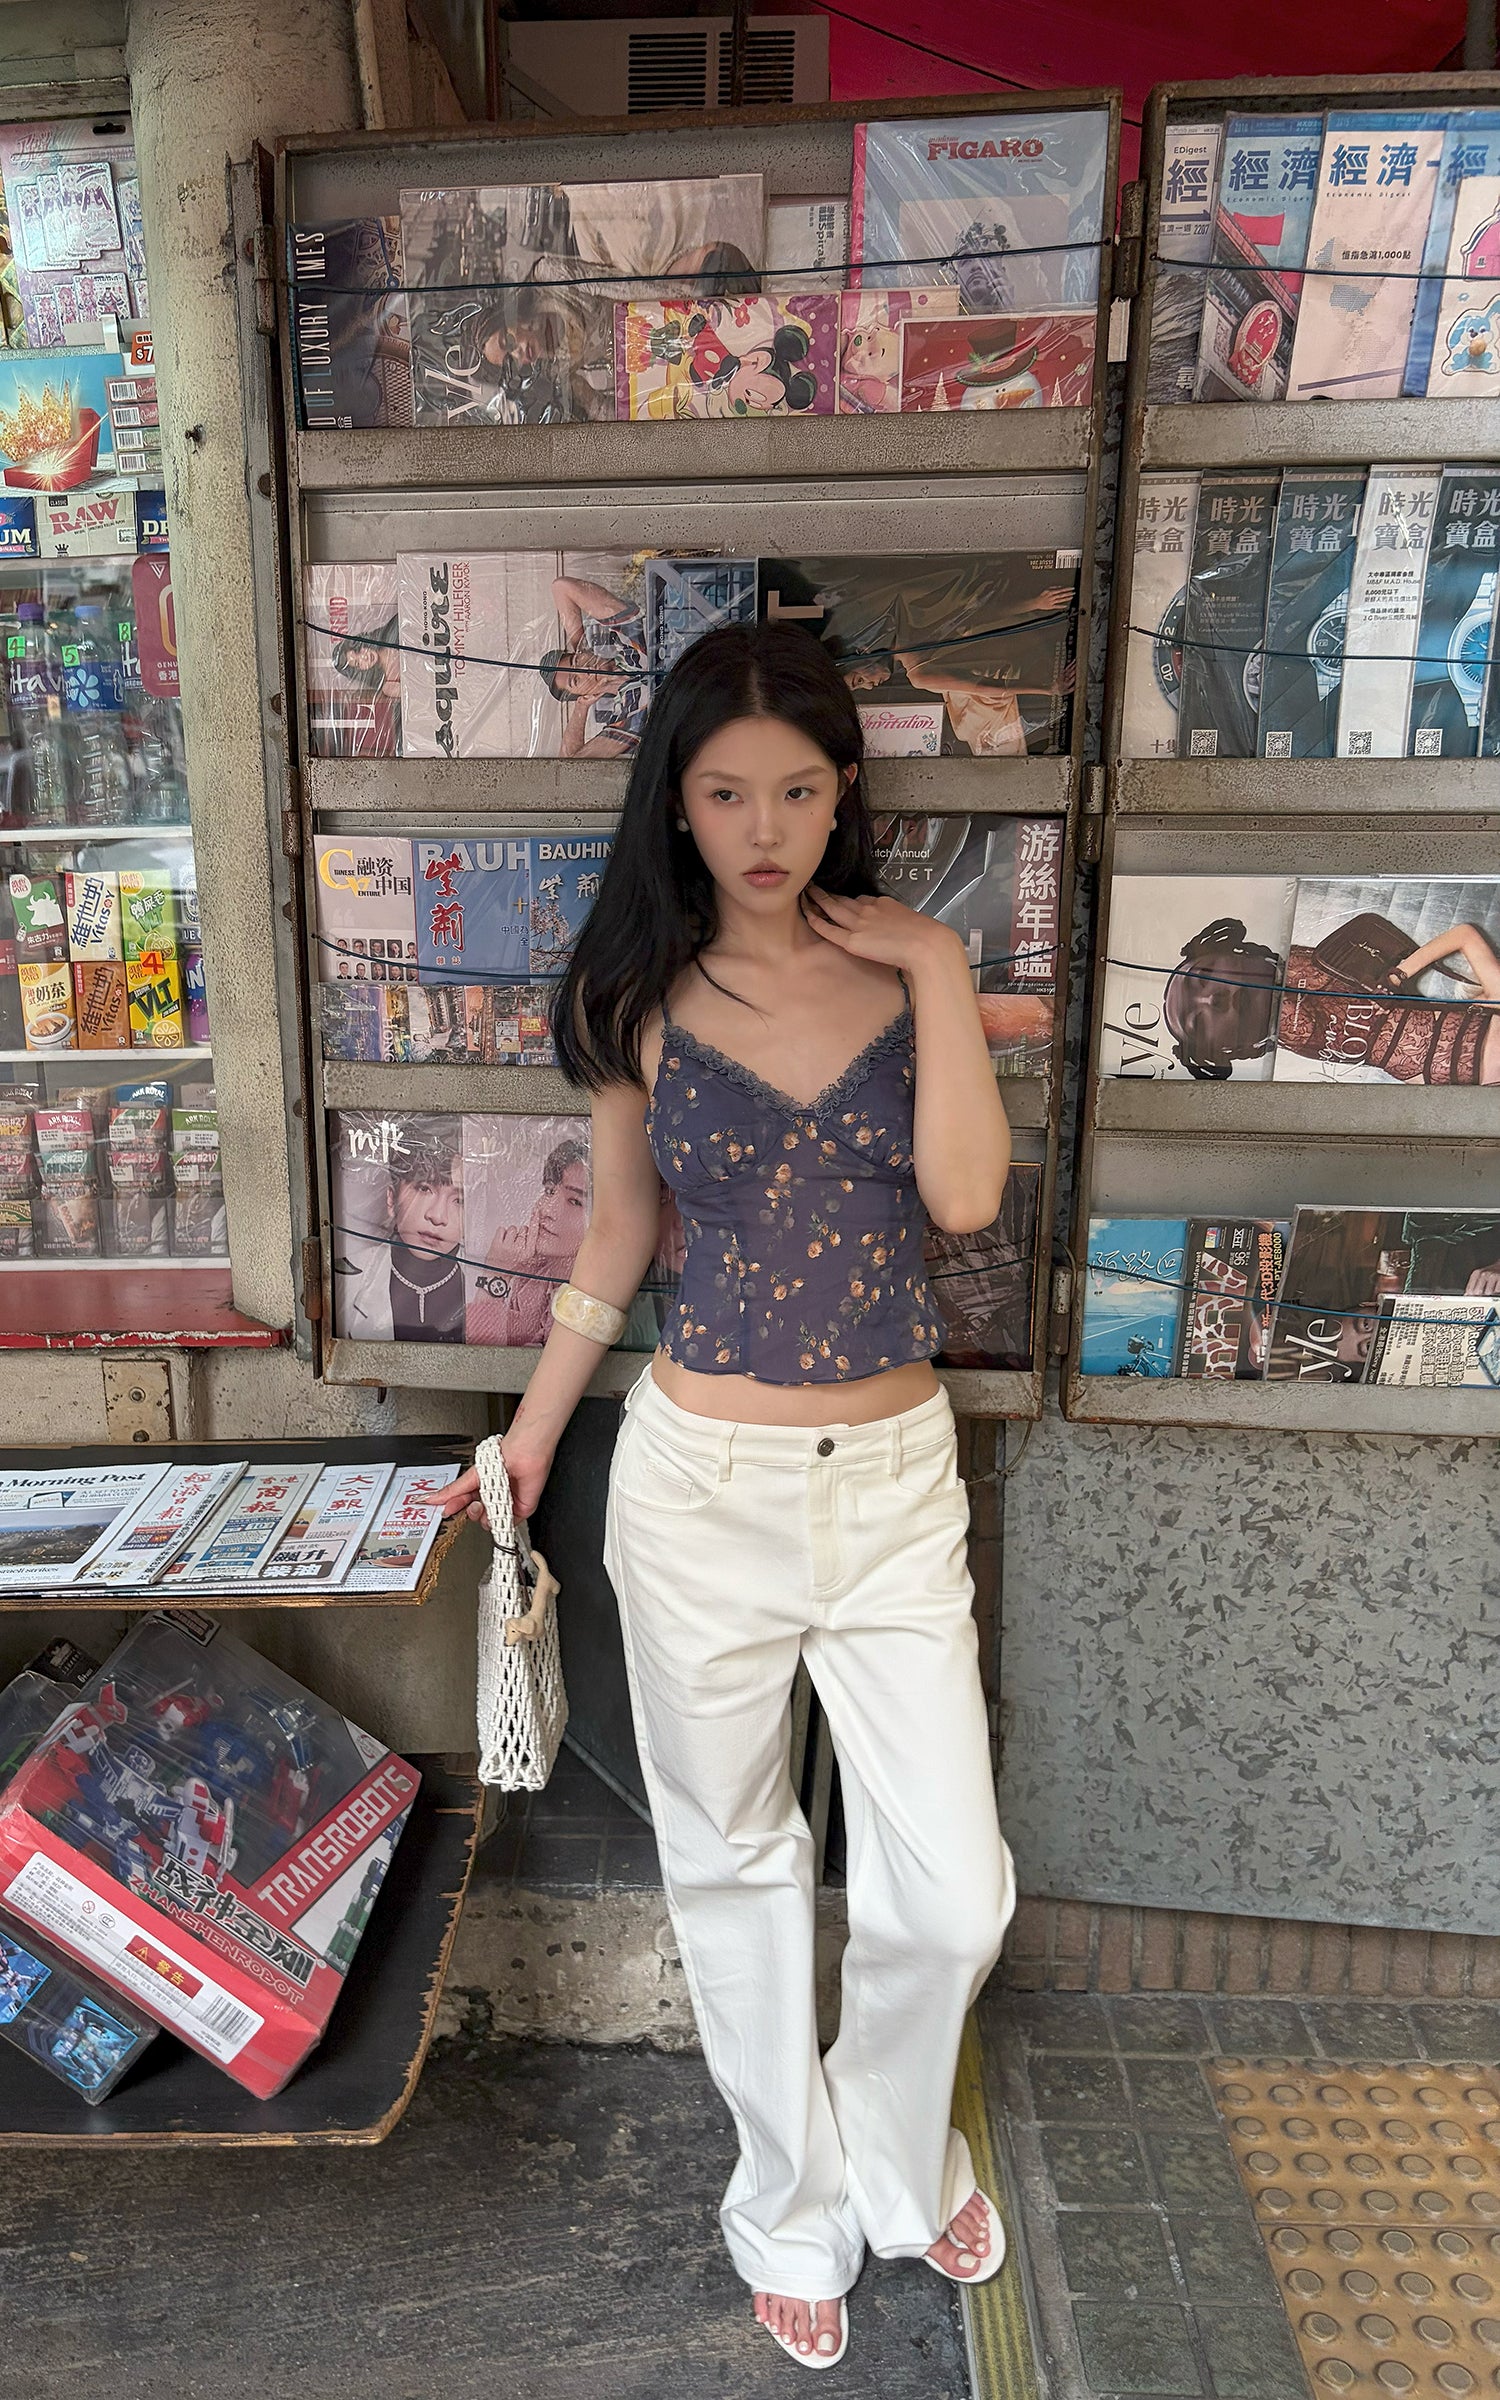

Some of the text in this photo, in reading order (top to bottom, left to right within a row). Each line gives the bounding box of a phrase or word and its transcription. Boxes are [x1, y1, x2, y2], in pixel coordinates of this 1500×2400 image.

[927, 138, 1044, 161] FIGARO
[1173, 146, 1208, 155] EDigest
[1165, 159, 1210, 204] 經
[1228, 147, 1320, 191] 經濟
[297, 302, 333, 377] LUXURY
[49, 498, 120, 536] RAW
[1138, 497, 1188, 523] 時光
[1210, 496, 1265, 524] 時光
[1291, 493, 1347, 522] 時光
[1378, 491, 1434, 519] 時光
[1449, 488, 1500, 518] 時光
[1135, 527, 1186, 554] 寶盒
[1207, 527, 1262, 556] 寶盒
[1289, 525, 1343, 554] 寶盒
[1373, 523, 1429, 552] 寶盒
[1445, 520, 1499, 550] 寶盒
[462, 562, 471, 589] KWOK
[120, 623, 130, 642] 8
[452, 562, 466, 679] TOMMY HILFIGER
[9, 637, 26, 658] 4
[64, 646, 76, 664] 5
[158, 670, 178, 681] 香港
[356, 856, 394, 878] 融资
[418, 841, 530, 872] BAUH
[895, 848, 930, 858] Annual
[375, 876, 412, 897] 中国
[70, 877, 105, 951] 維他奶
[141, 952, 165, 975] 4
[36, 981, 67, 1002] 奶茶
[80, 967, 115, 1037] 維他奶
[135, 977, 174, 1021] VLT
[1234, 1251, 1246, 1266] 96
[1272, 1232, 1283, 1281] PT-AE8000
[5, 1472, 147, 1489] Morning Post
[326, 1474, 375, 1512] 大公報
[24, 1566, 59, 1574] strikes
[259, 1764, 412, 1918] TRANSROBOTS
[129, 1873, 306, 2005] ZHANSHENROBOT
[156, 1957, 185, 1987] 警告
